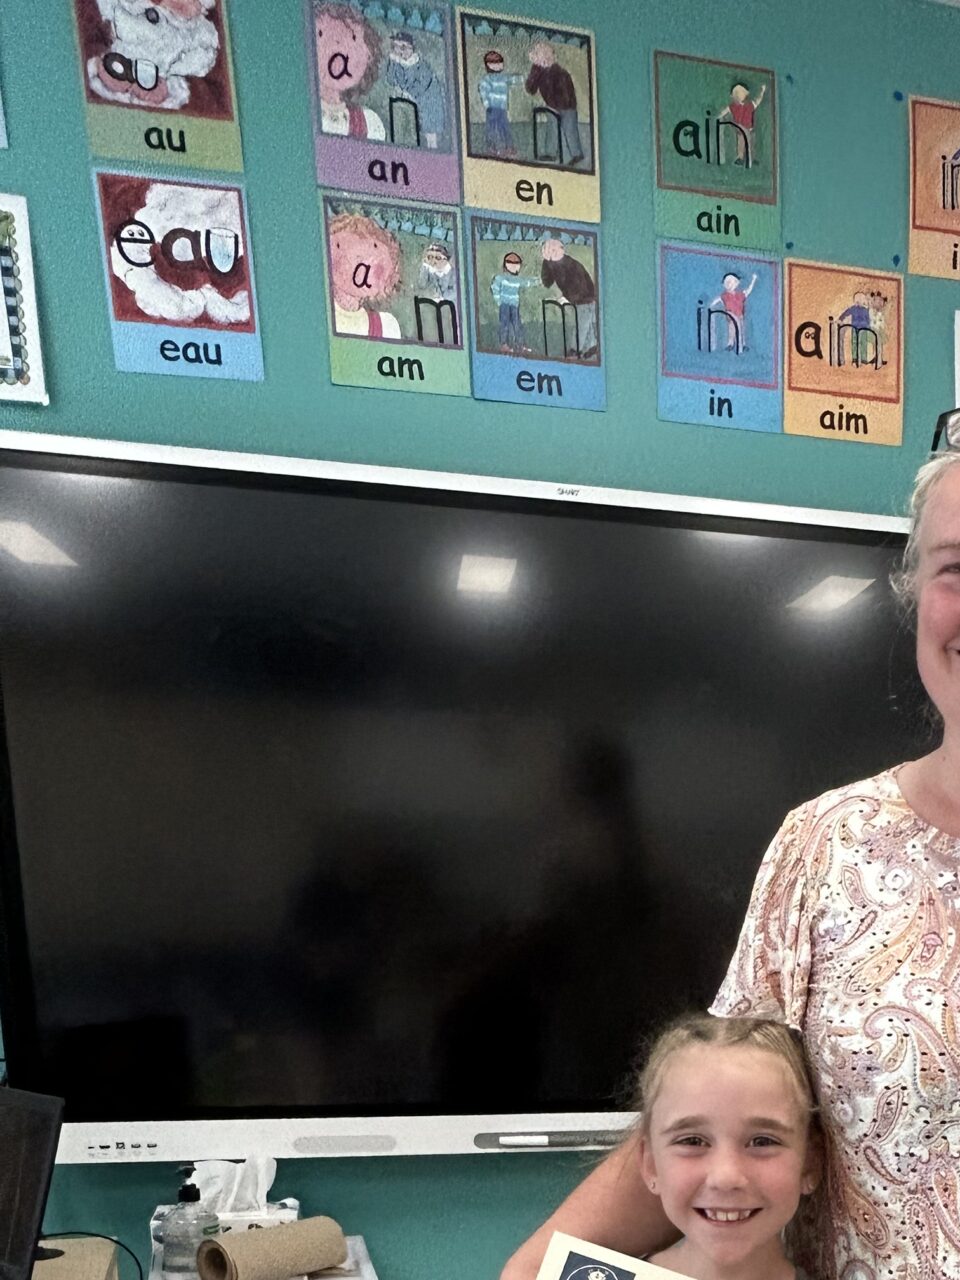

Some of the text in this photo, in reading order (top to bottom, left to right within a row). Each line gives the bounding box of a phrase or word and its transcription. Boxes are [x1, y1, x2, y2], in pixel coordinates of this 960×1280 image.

[144, 127, 186, 152] au
[369, 157, 410, 187] an
[516, 179, 553, 206] en
[697, 207, 740, 237] ain
[160, 335, 222, 366] eau
[377, 355, 425, 381] am
[516, 370, 563, 396] em
[709, 390, 733, 418] in
[820, 405, 868, 434] aim
